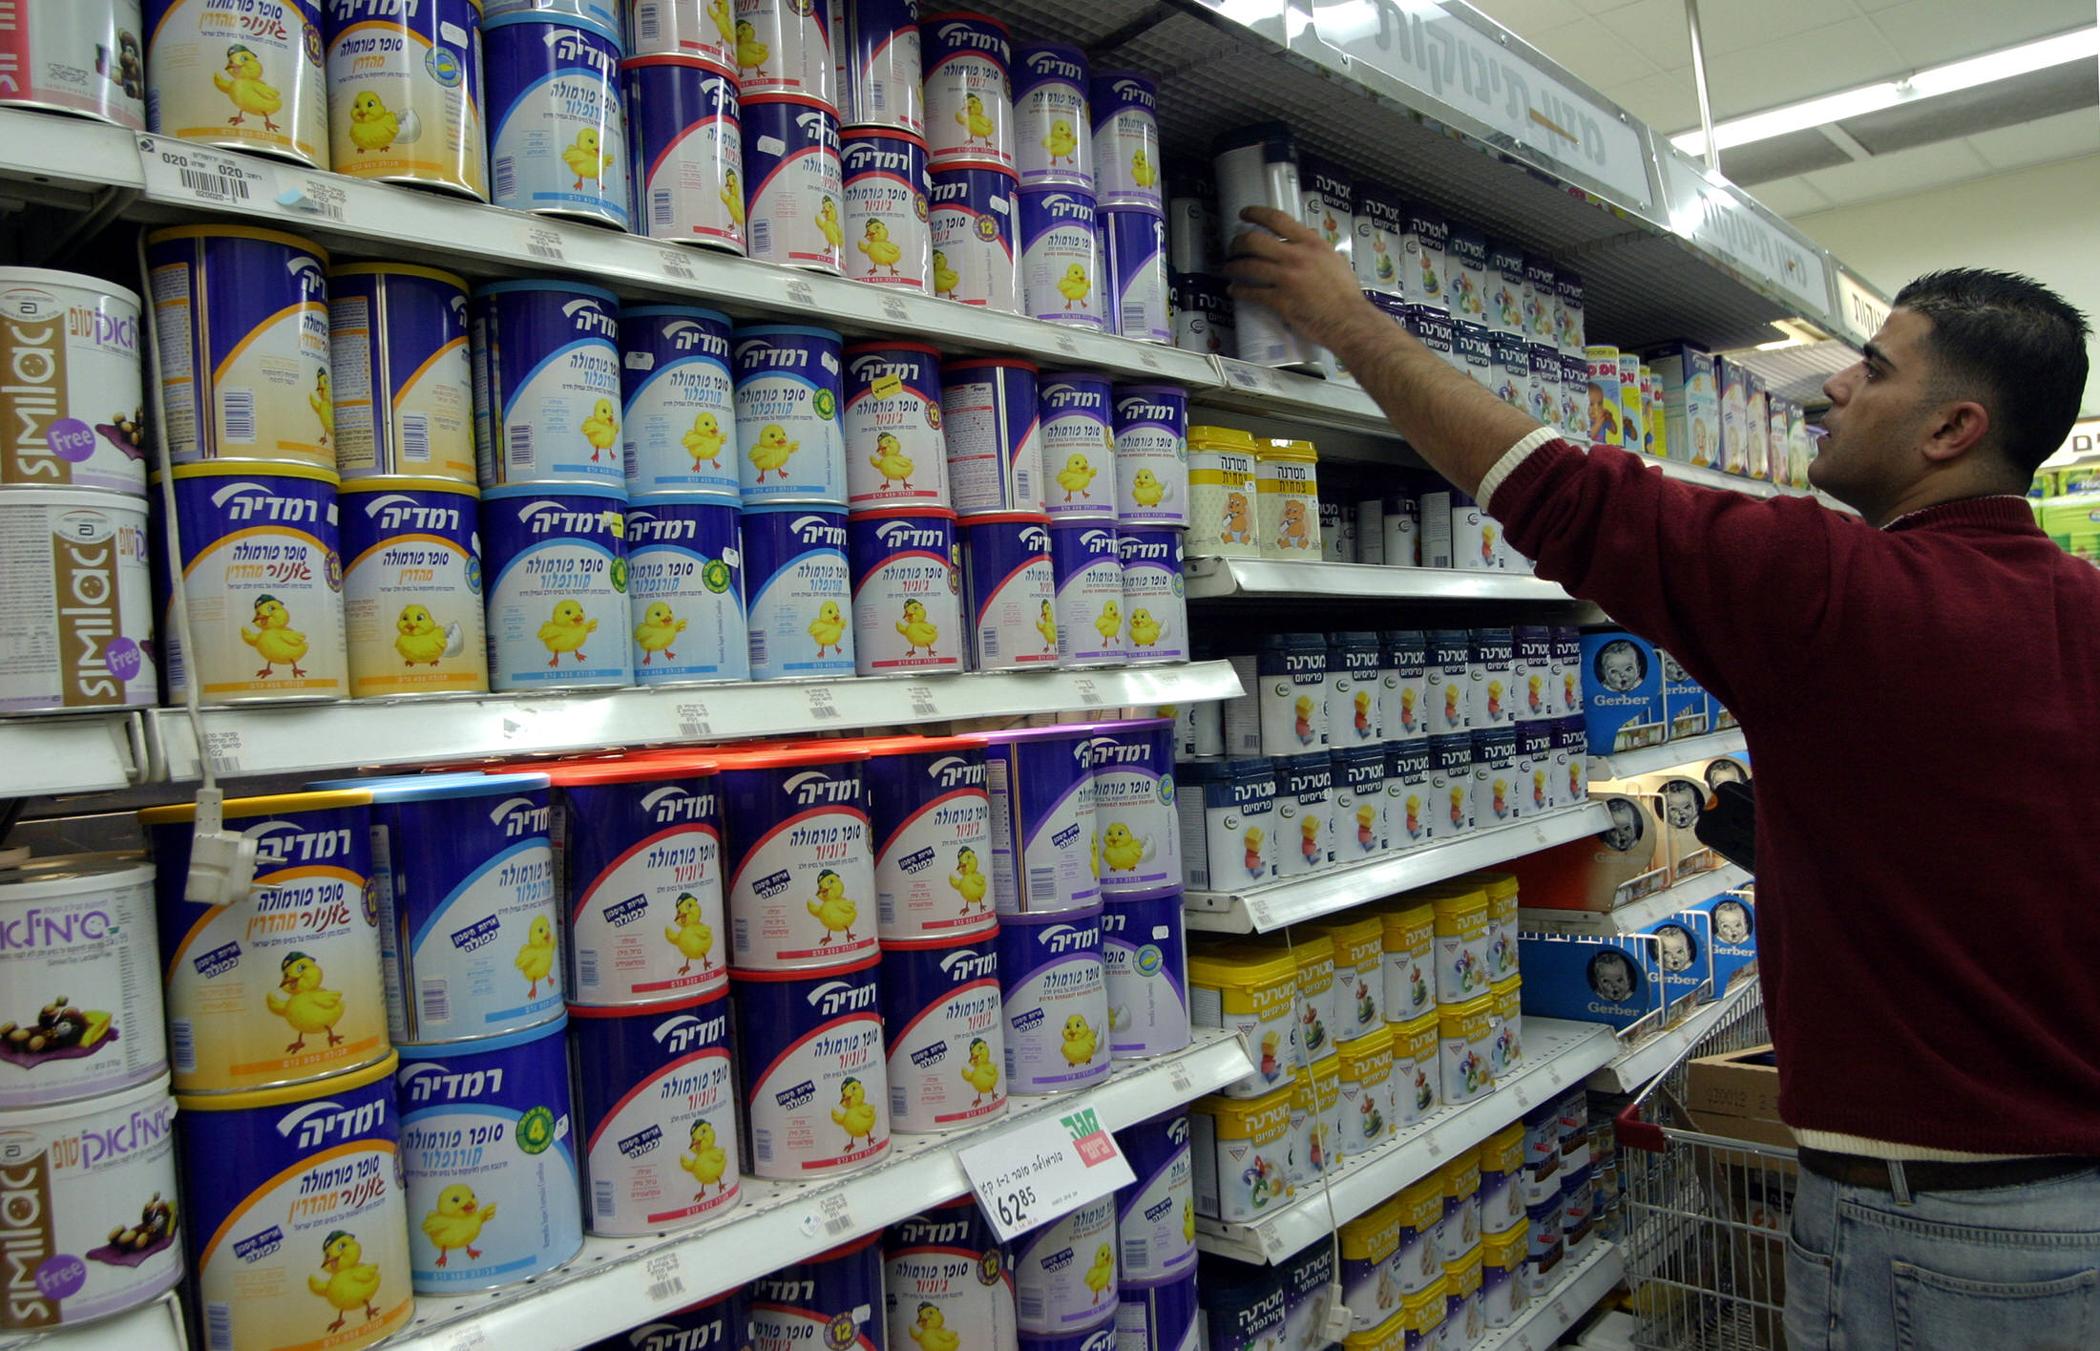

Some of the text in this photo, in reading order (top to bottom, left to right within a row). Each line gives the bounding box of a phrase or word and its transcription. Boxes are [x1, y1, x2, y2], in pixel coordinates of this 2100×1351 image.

[162, 153, 188, 167] 020
[218, 164, 242, 178] 020
[980, 221, 993, 235] 12
[52, 428, 91, 451] Free
[230, 497, 317, 521] רמדיה
[381, 507, 458, 530] רמדיה
[628, 519, 696, 542] רמדיה
[111, 649, 140, 671] Free
[1287, 654, 1326, 671] מטרנה
[1594, 694, 1649, 707] Gerber
[1664, 684, 1705, 696] erber
[1093, 744, 1150, 763] רמדיה
[1291, 773, 1330, 792] מטרנה
[1348, 763, 1384, 782] מטרנה
[799, 779, 859, 805] רמדיה
[258, 829, 351, 860] רמדיה
[258, 887, 309, 910] פורמולה
[1712, 945, 1755, 957] Gerber
[823, 982, 876, 1015] רמדיה
[1588, 1002, 1639, 1018] Gerber
[412, 1069, 502, 1099] רמדיה
[299, 1099, 384, 1149] רמדיה
[530, 1119, 545, 1141] 4
[422, 1147, 482, 1168] קורנפלור
[903, 1221, 968, 1242] רמדיה
[40, 1260, 85, 1292] Free
[985, 1262, 997, 1274] 12
[835, 1323, 852, 1341] 12
